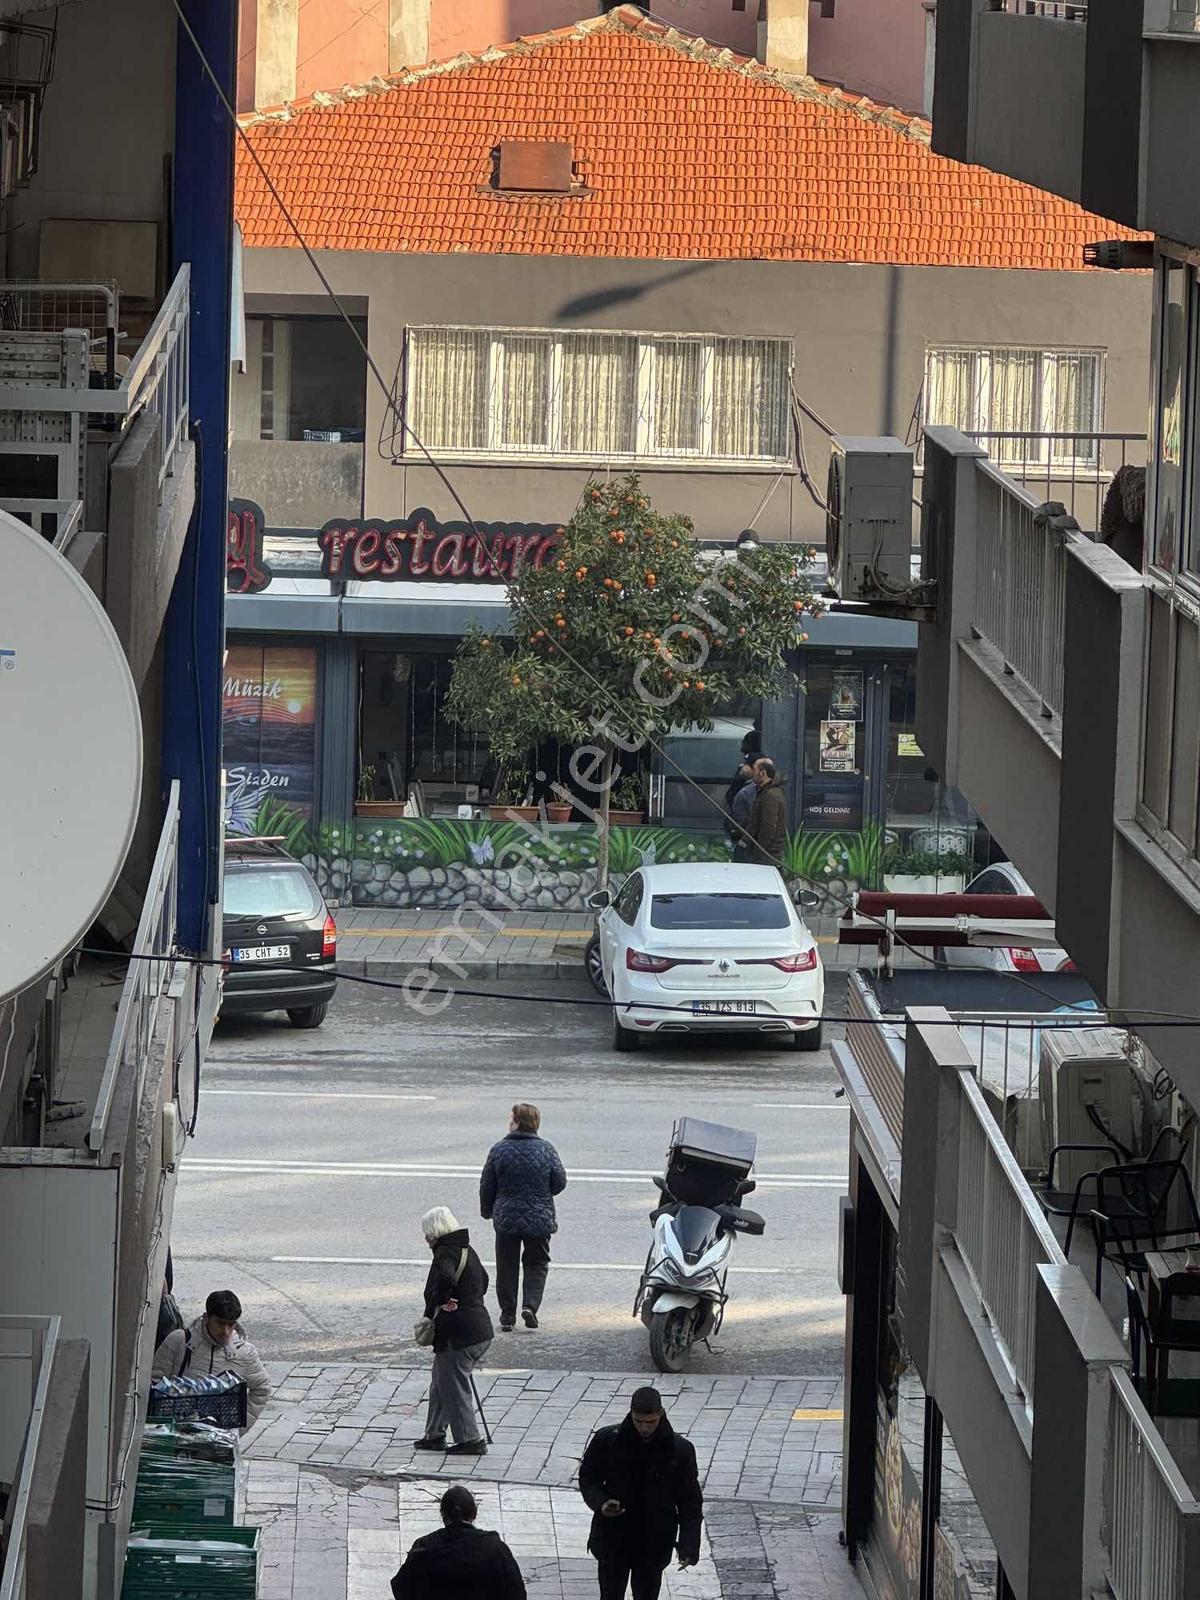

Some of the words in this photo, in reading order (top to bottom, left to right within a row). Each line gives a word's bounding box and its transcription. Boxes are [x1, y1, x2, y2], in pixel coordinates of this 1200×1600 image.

[223, 676, 283, 699] Müzik
[240, 949, 250, 959] 35
[255, 947, 271, 958] CHT
[277, 946, 289, 956] 52
[700, 1000, 711, 1011] 35
[736, 1000, 753, 1012] 813
